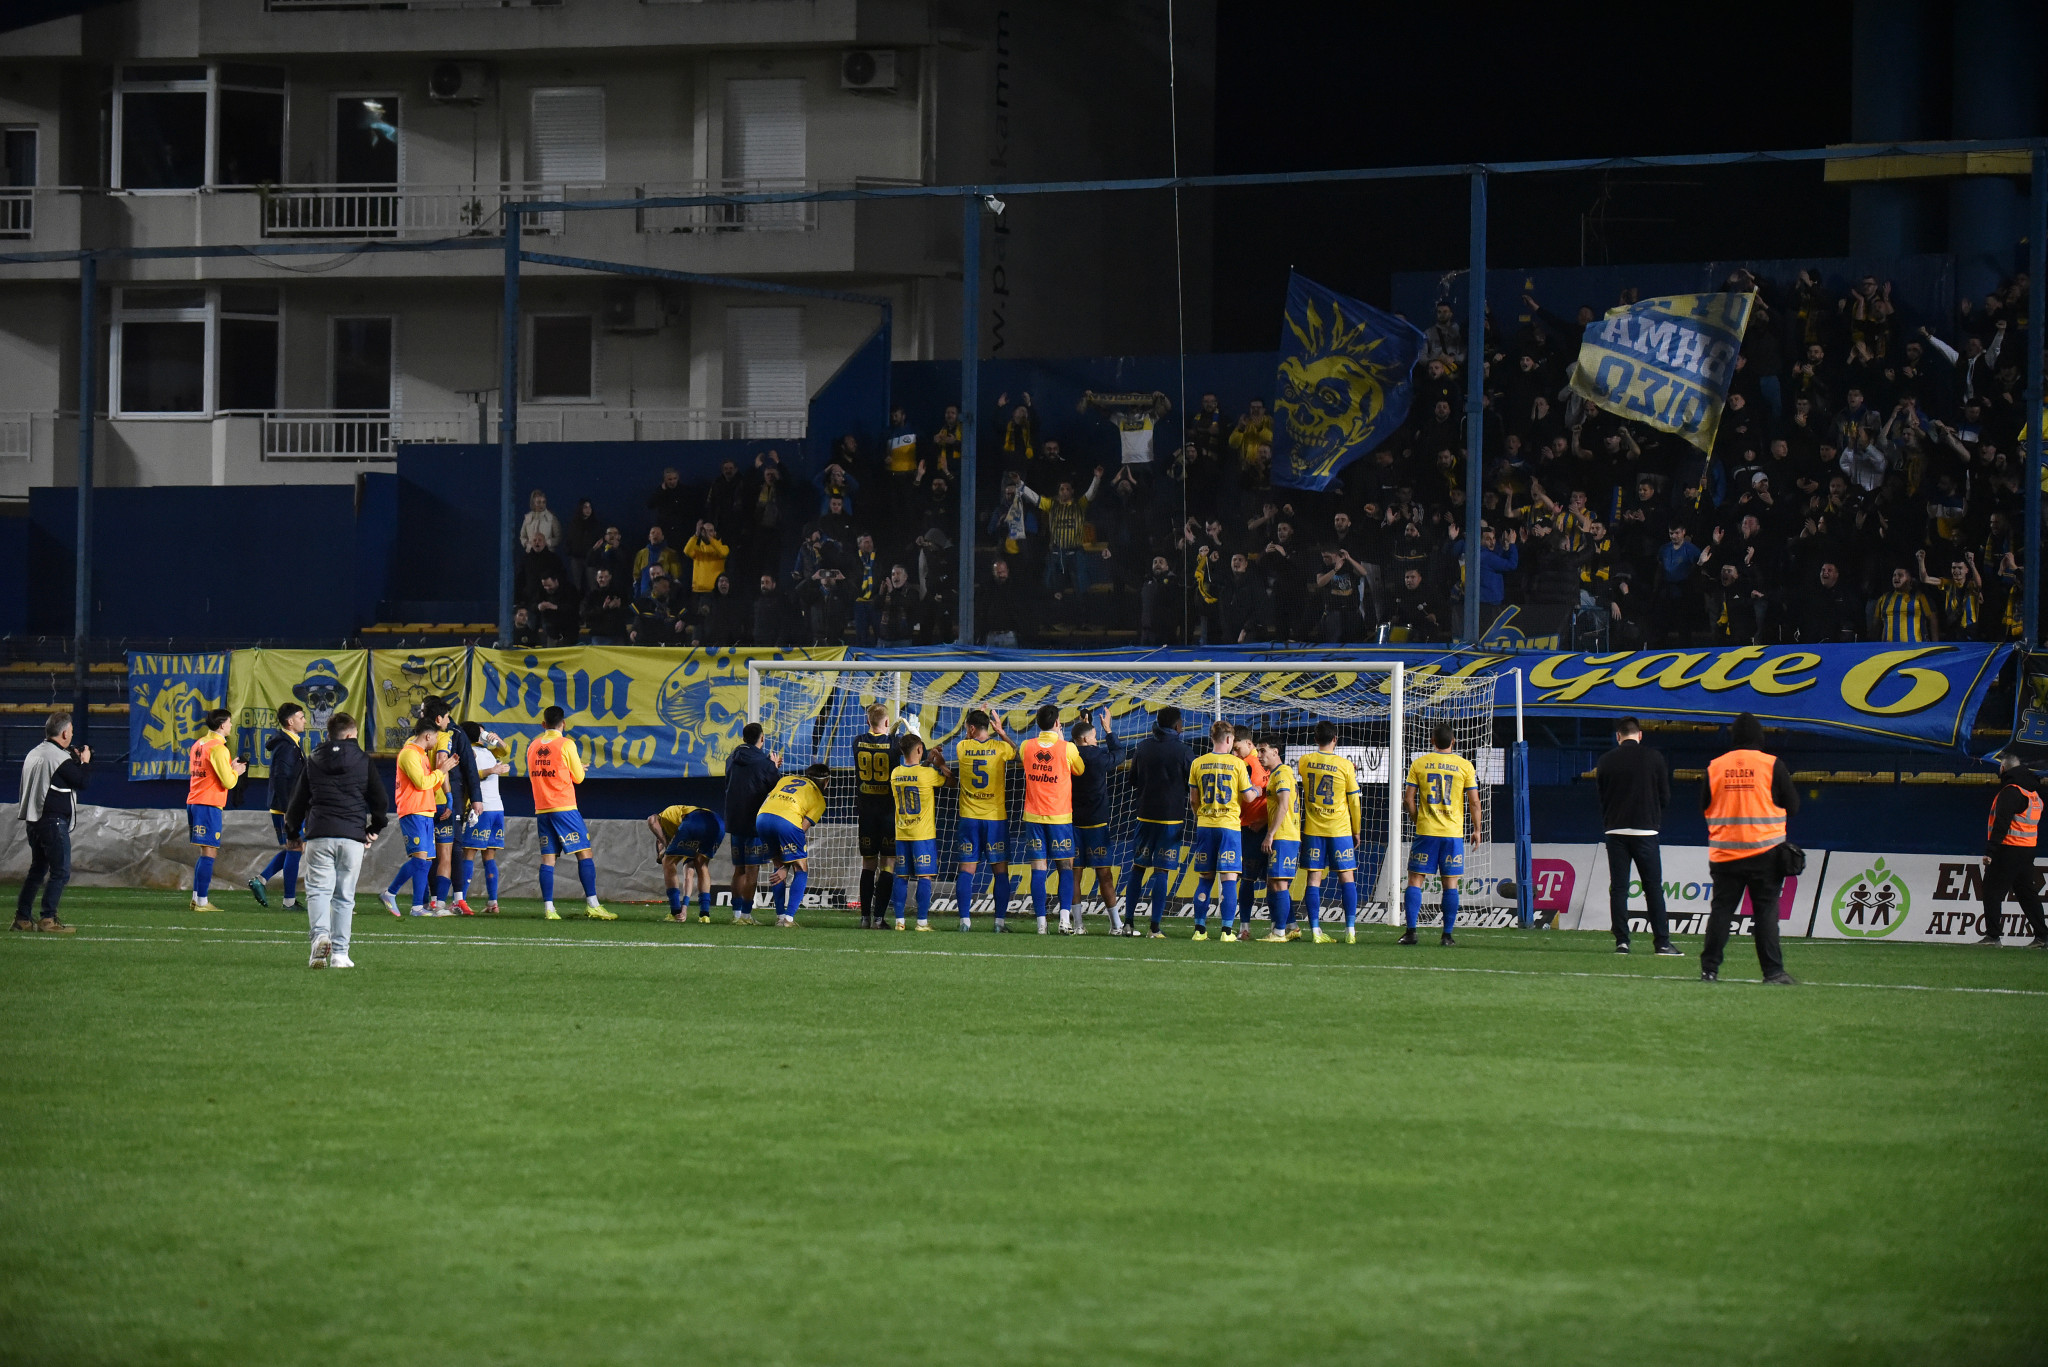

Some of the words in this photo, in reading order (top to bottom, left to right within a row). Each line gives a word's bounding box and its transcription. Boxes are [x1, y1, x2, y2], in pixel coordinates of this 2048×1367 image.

[133, 655, 225, 675] ANTINAZI
[1529, 645, 1819, 702] Gate
[1840, 646, 1951, 716] 6
[241, 707, 280, 728] ΘΥΡ
[857, 751, 889, 782] 99
[972, 759, 989, 789] 5
[1028, 773, 1058, 784] novibet
[1032, 763, 1053, 772] errea
[1725, 769, 1755, 778] GOLDEN
[780, 779, 807, 794] 2
[895, 786, 921, 814] 10
[1201, 773, 1232, 805] 65
[1307, 772, 1334, 805] 14
[1427, 773, 1453, 806] 31
